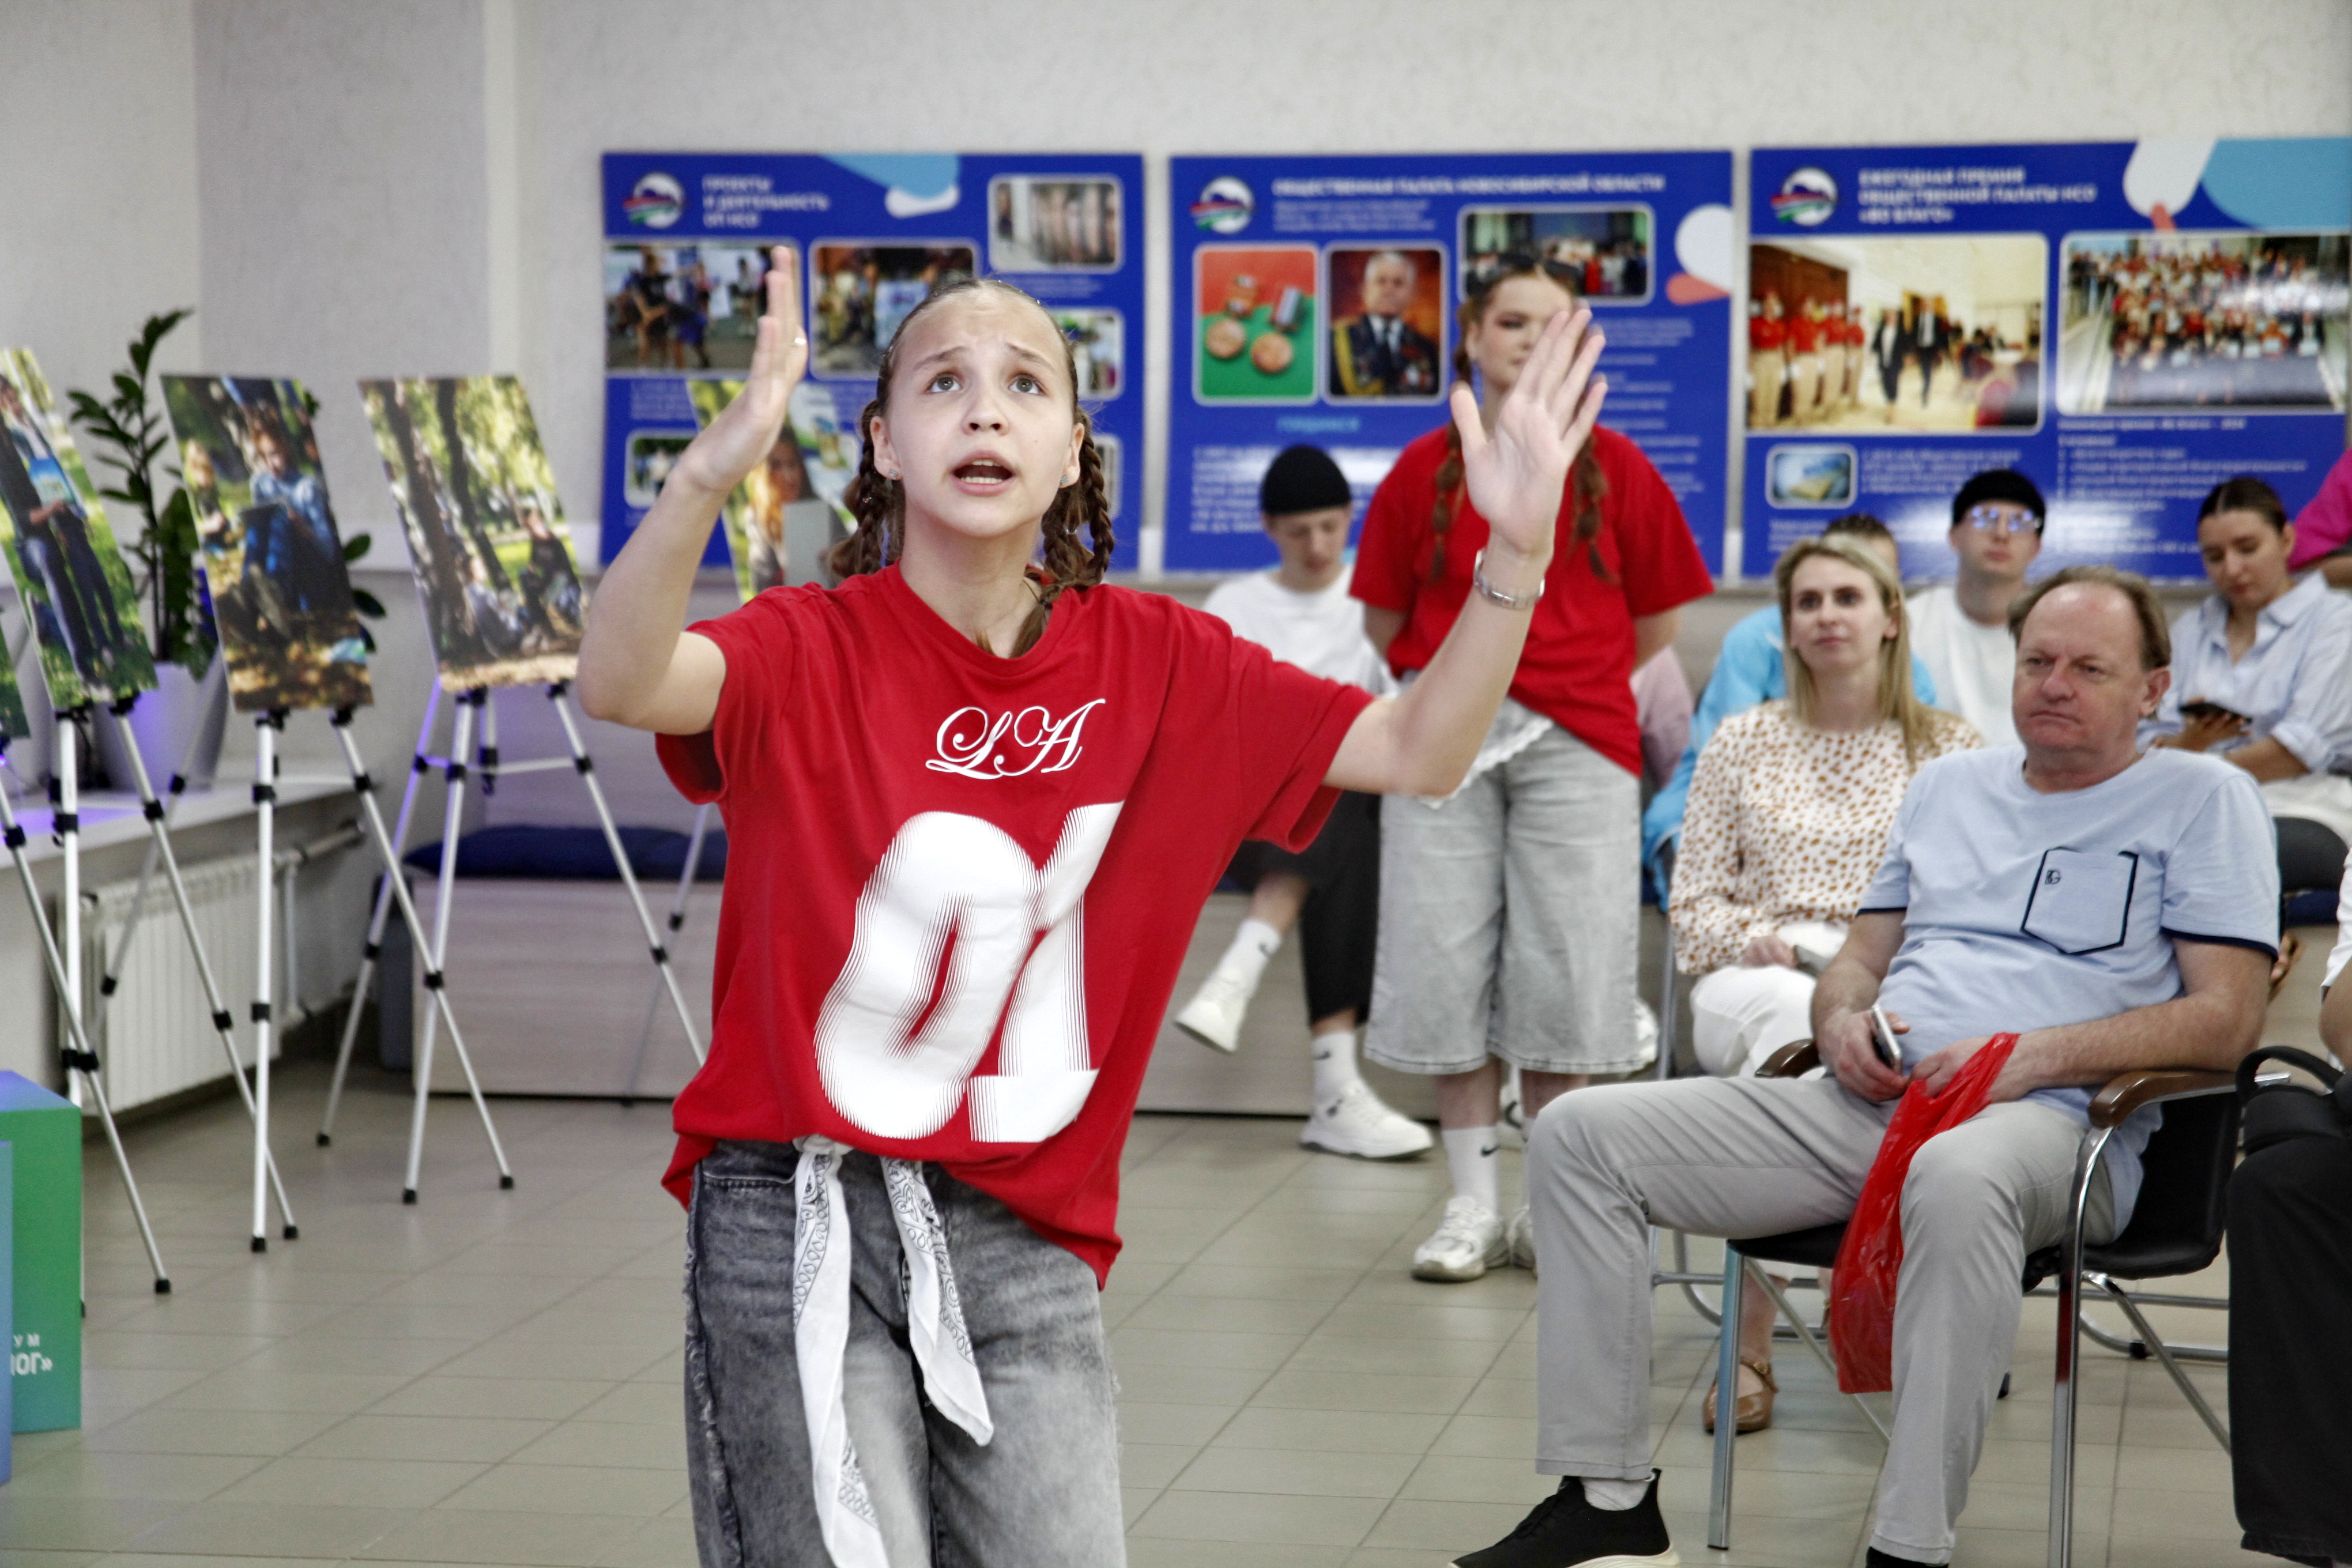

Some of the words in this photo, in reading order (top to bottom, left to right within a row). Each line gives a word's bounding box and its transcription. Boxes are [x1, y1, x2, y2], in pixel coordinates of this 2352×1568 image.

[702, 175, 773, 191] ПРОЕКТЫ
[1271, 178, 1393, 197] ОБЩЕСТВЕННАЯ
[1396, 178, 1453, 195] ПАЛАТА
[1455, 171, 1589, 194] НОВОСИБИРСКОЙ
[1592, 174, 1665, 194] ОБЛАСТИ
[1859, 169, 1955, 186] ЕЖЕГОДНАЯ
[1957, 167, 2026, 184] ПРЕМИЯ
[717, 193, 830, 212] ДЕЯТЕЛЬНОСТЬ
[1858, 187, 1989, 205] ОБЩЕСТВЕННОЙ
[1992, 185, 2058, 203] ПАЛАТЫ
[2061, 183, 2098, 203] НСО
[925, 698, 1106, 780] LA
[813, 801, 1125, 1143] 01
